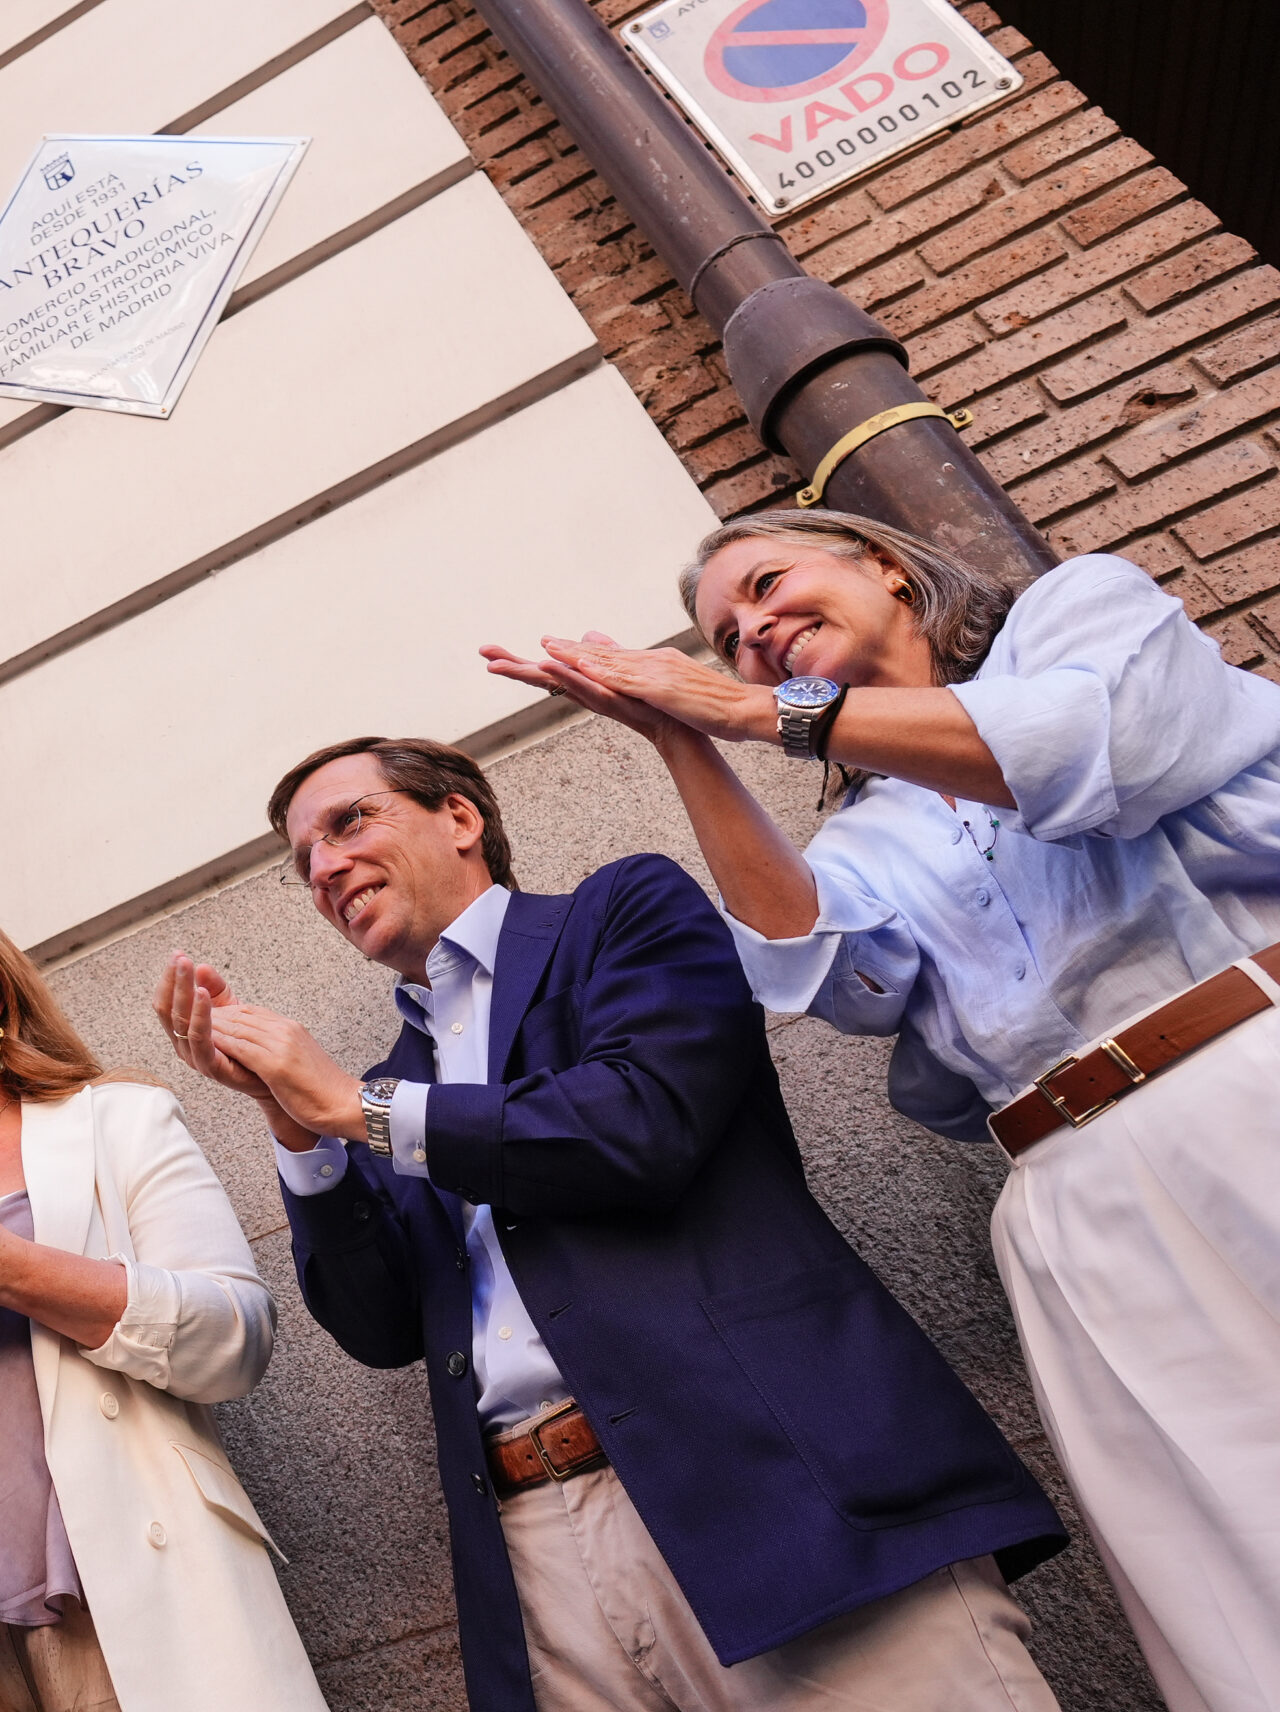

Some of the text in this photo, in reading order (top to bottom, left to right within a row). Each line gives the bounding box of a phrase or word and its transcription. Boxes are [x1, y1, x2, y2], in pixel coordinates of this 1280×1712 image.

[748, 41, 951, 155] VADO
[778, 68, 987, 190] 4000000102
[30, 181, 126, 246] DESDE 1931
[42, 218, 146, 290] BRAVO
[0, 232, 235, 377] FAMILIAR E HISTORIA VIVA
[3, 315, 59, 356] ICONO
[70, 282, 172, 350] DE MADRID
